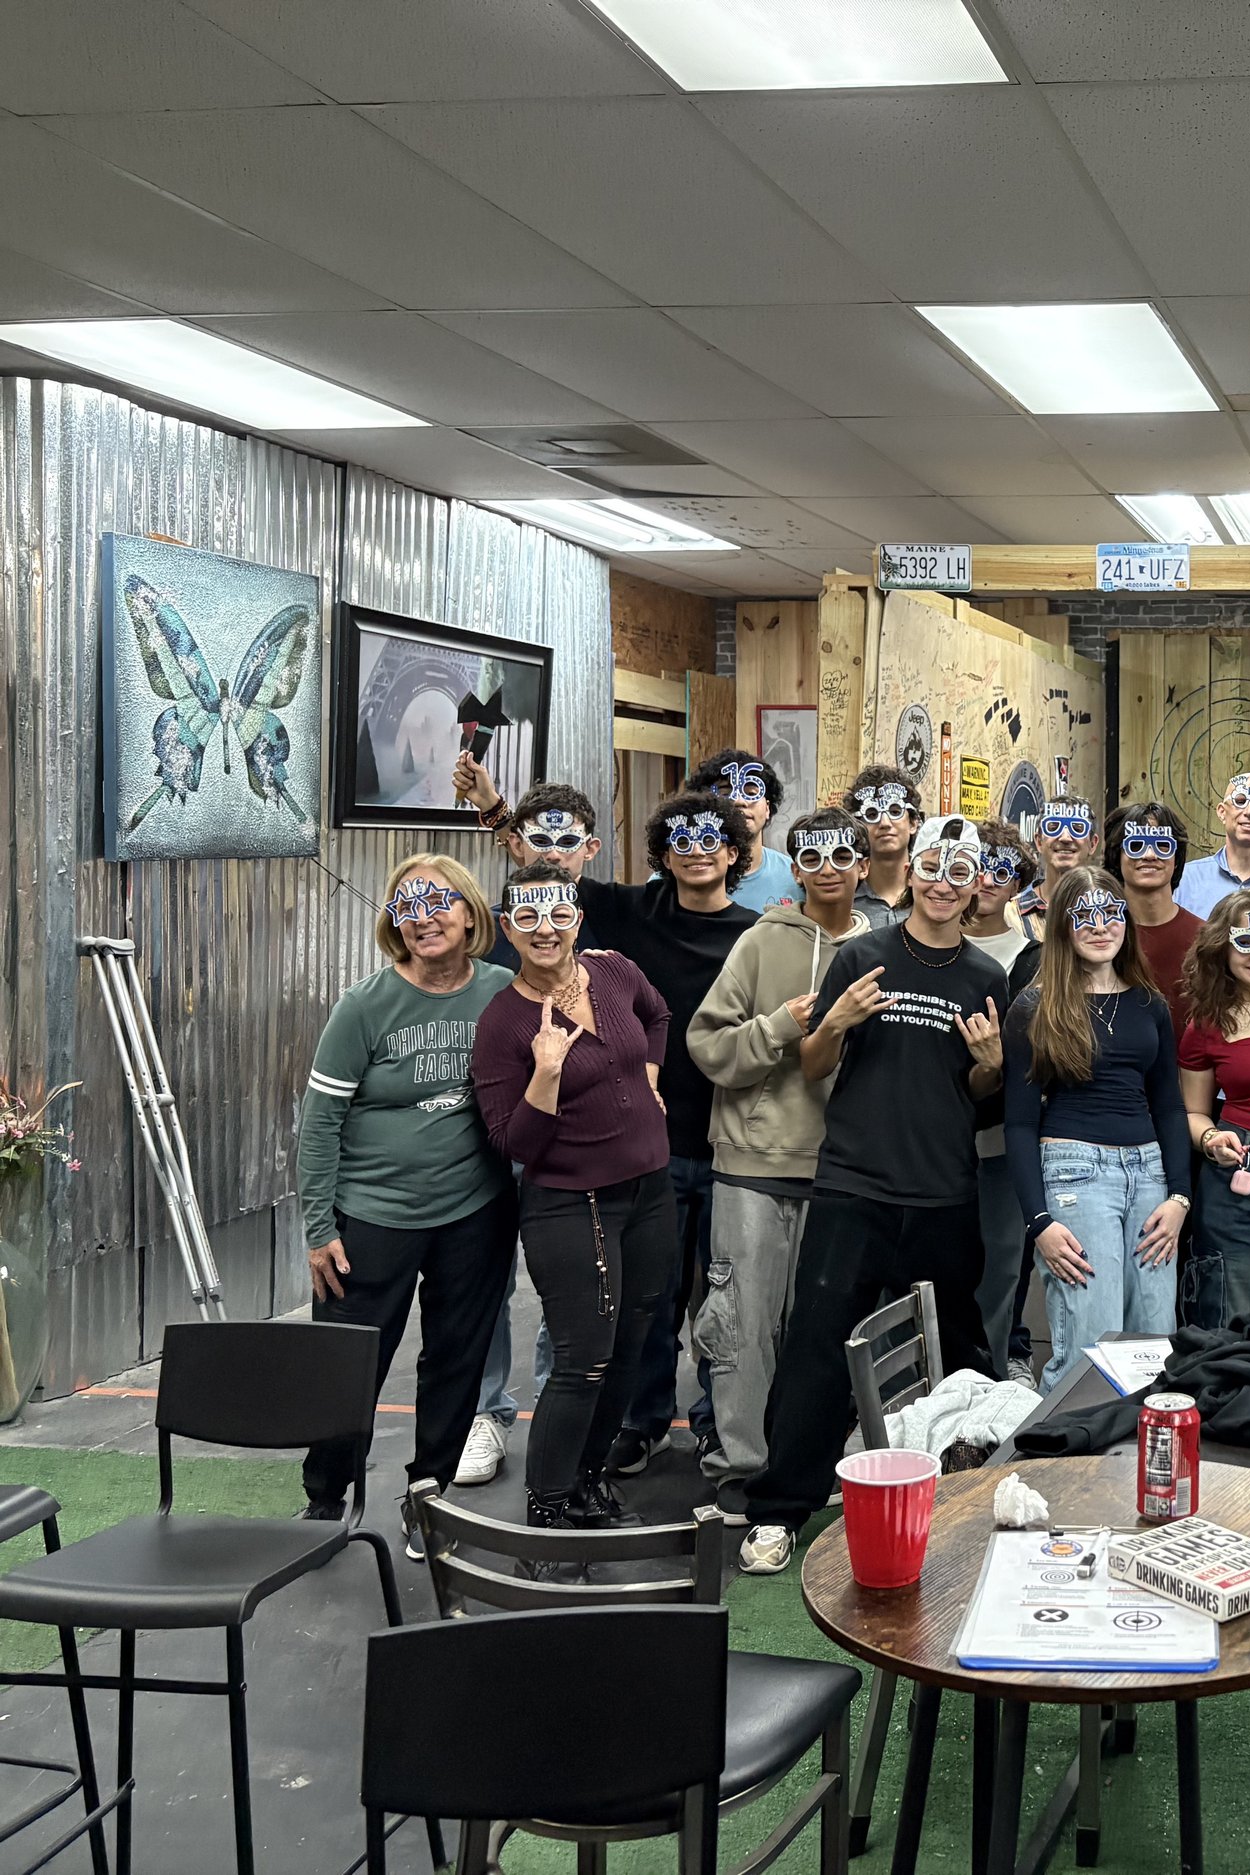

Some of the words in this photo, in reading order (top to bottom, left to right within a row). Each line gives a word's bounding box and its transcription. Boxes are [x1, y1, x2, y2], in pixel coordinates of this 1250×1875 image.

[899, 556, 937, 579] 5392
[947, 557, 966, 580] LH
[1102, 559, 1135, 580] 241
[1149, 558, 1184, 580] UFZ
[908, 711, 924, 725] Jeep
[721, 762, 766, 803] 16
[855, 786, 876, 800] HAPPY
[1124, 821, 1173, 837] Sixteen
[930, 838, 979, 888] 16
[404, 876, 427, 898] 16
[1085, 889, 1105, 906] 16
[947, 1001, 962, 1013] TO
[881, 1014, 900, 1023] ON
[901, 1015, 951, 1033] YOUTUBE
[387, 1021, 477, 1059] PHILADELP
[414, 1052, 472, 1084] EAGLE
[1117, 1517, 1209, 1552] DRINKING
[1144, 1528, 1243, 1567] GAMES
[1175, 1561, 1200, 1574] FOR
[1200, 1547, 1235, 1566] PEOPLE
[1194, 1565, 1231, 1582] NEVER
[1135, 1561, 1184, 1599] DRINKING
[1185, 1583, 1220, 1616] GAMES
